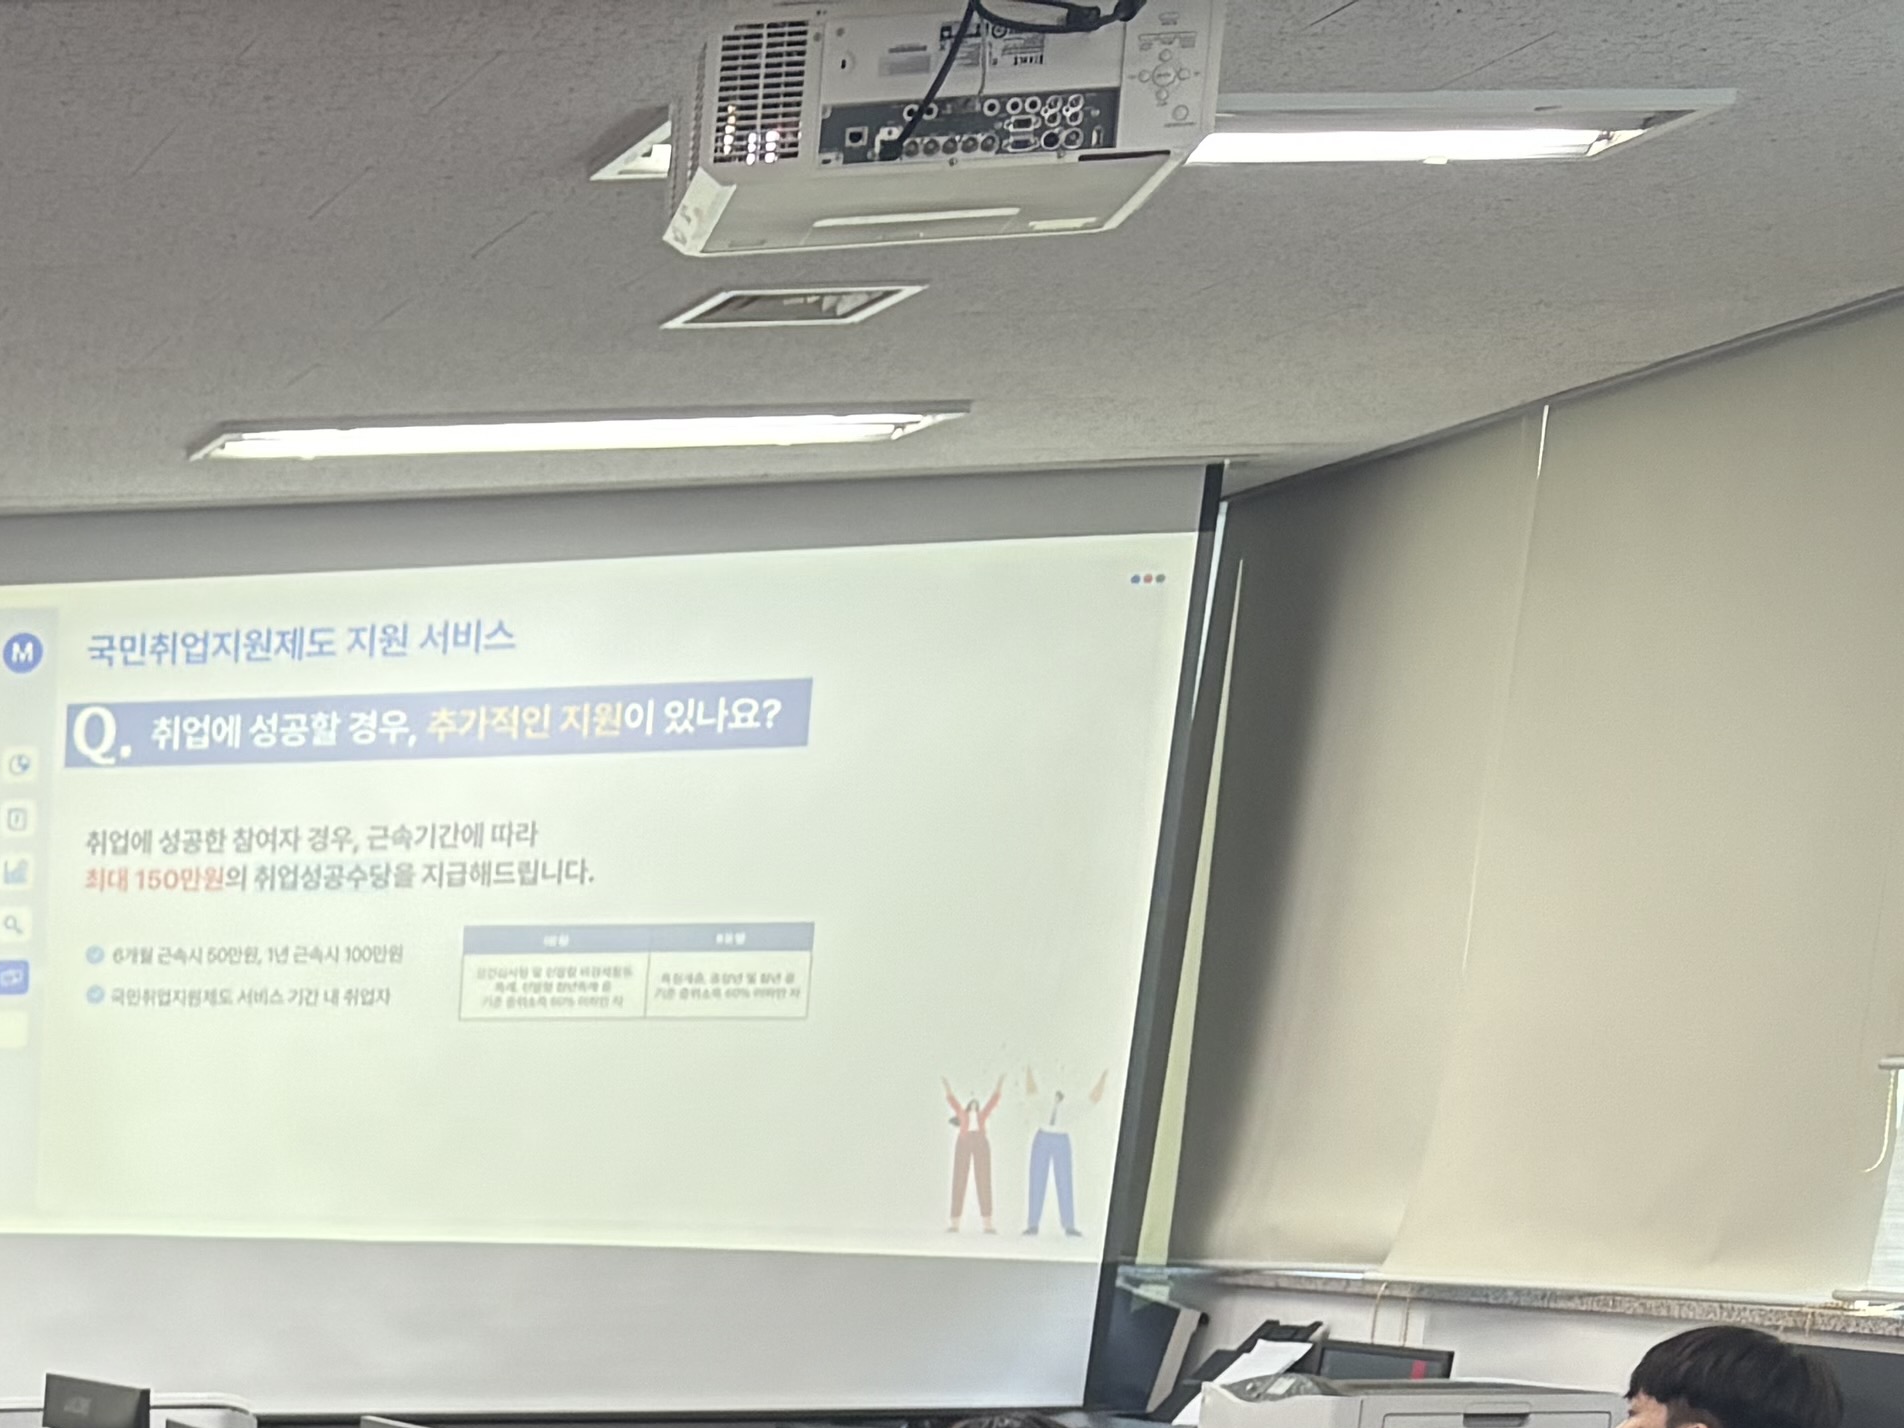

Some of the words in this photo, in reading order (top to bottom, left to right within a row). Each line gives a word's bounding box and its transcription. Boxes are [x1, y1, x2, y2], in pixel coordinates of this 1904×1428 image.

[88, 627, 336, 666] 국민취업지원제도
[347, 621, 409, 659] 지원
[419, 617, 516, 656] 서비스
[73, 705, 132, 766] Q.
[152, 713, 241, 752] 취업에
[248, 711, 342, 749] 성공할
[348, 708, 417, 747] 경우,
[426, 703, 551, 742] 추가적인
[560, 698, 654, 739] 지원이
[663, 696, 782, 735] 있나요?
[86, 828, 153, 856] 취업에
[159, 827, 226, 855] 성공한
[232, 826, 301, 854] 참여자
[307, 825, 360, 856] 경우,
[367, 822, 485, 851] 근속기간에
[491, 821, 538, 849] 따라
[85, 867, 129, 893] 최대
[136, 864, 248, 892] 150만원의
[254, 862, 415, 891] 취업성공수당을
[421, 858, 595, 888] 지급해드립니다.
